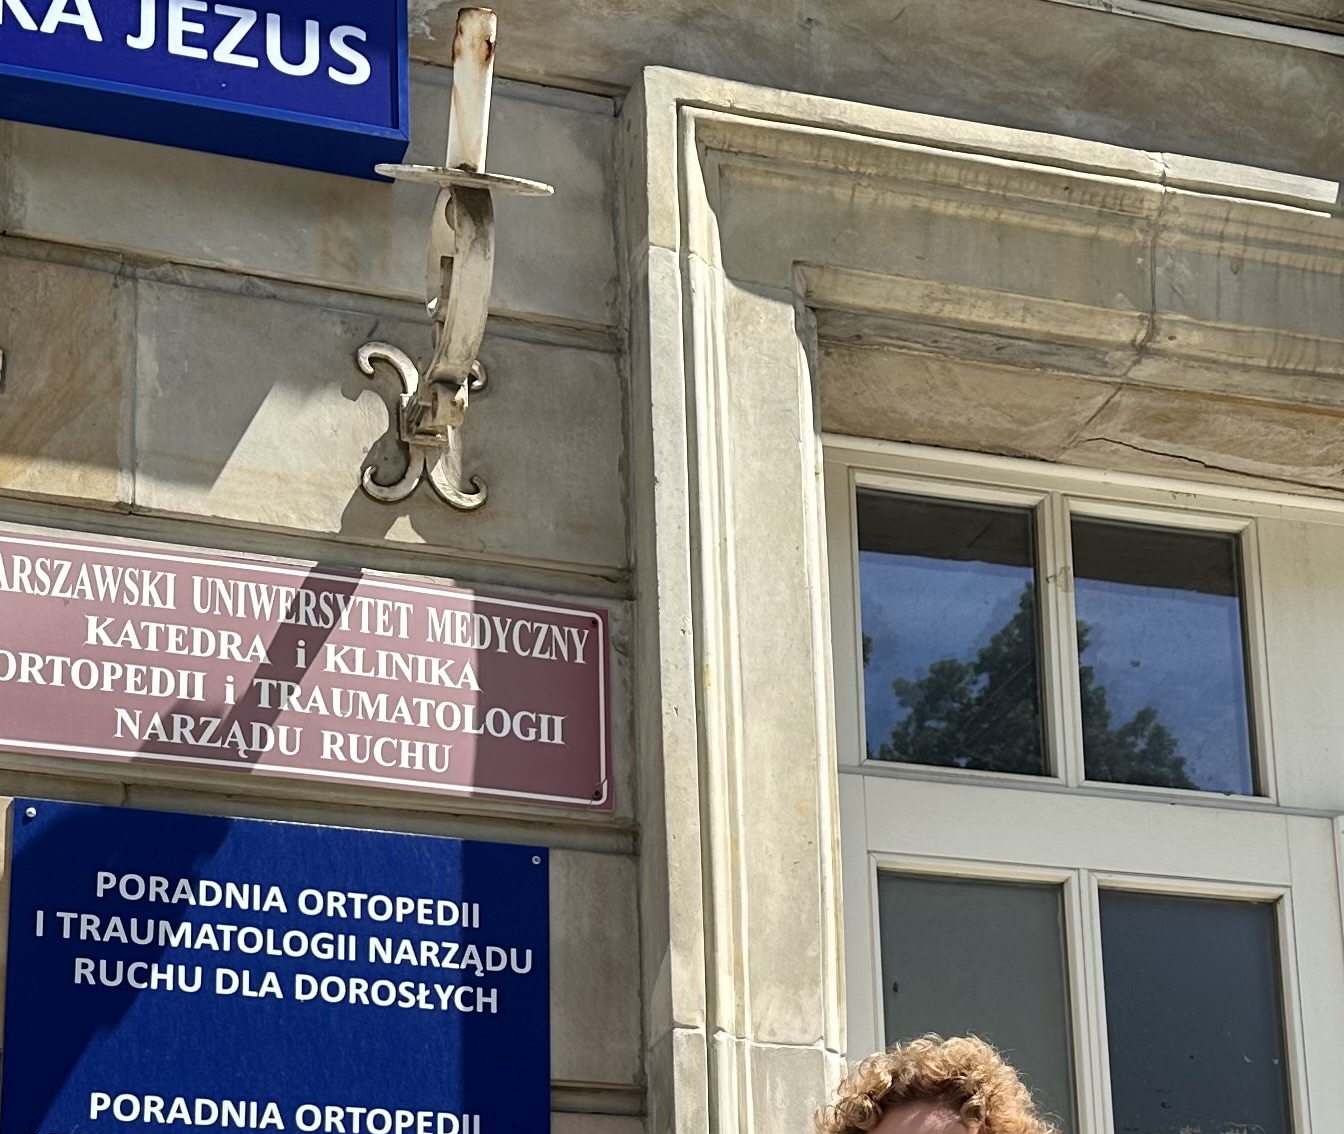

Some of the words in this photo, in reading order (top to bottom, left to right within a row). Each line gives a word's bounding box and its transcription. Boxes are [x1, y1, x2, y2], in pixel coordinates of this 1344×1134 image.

[126, 0, 371, 85] JEZUS
[83, 615, 269, 664] KATEDRA
[296, 640, 307, 669] i
[323, 645, 482, 692] KLINIKA
[192, 577, 414, 639] UNIWERSYTET
[426, 608, 590, 664] MEDYCZNY
[114, 707, 302, 758] NARZĄDU
[320, 730, 452, 773] RUCHU
[225, 676, 235, 705] i
[255, 677, 566, 745] TRAUMATOLOGII
[96, 871, 287, 912] PORADNIA
[297, 889, 479, 928] ORTOPEDII
[36, 910, 44, 937] I
[56, 912, 355, 962] TRAUMATOLOGII
[369, 938, 533, 978] NARZĄDU
[74, 957, 202, 992] RUCHU
[215, 969, 282, 999] DLA
[295, 974, 498, 1013] DOROSŁYCH
[90, 1092, 283, 1130] PORADNIA
